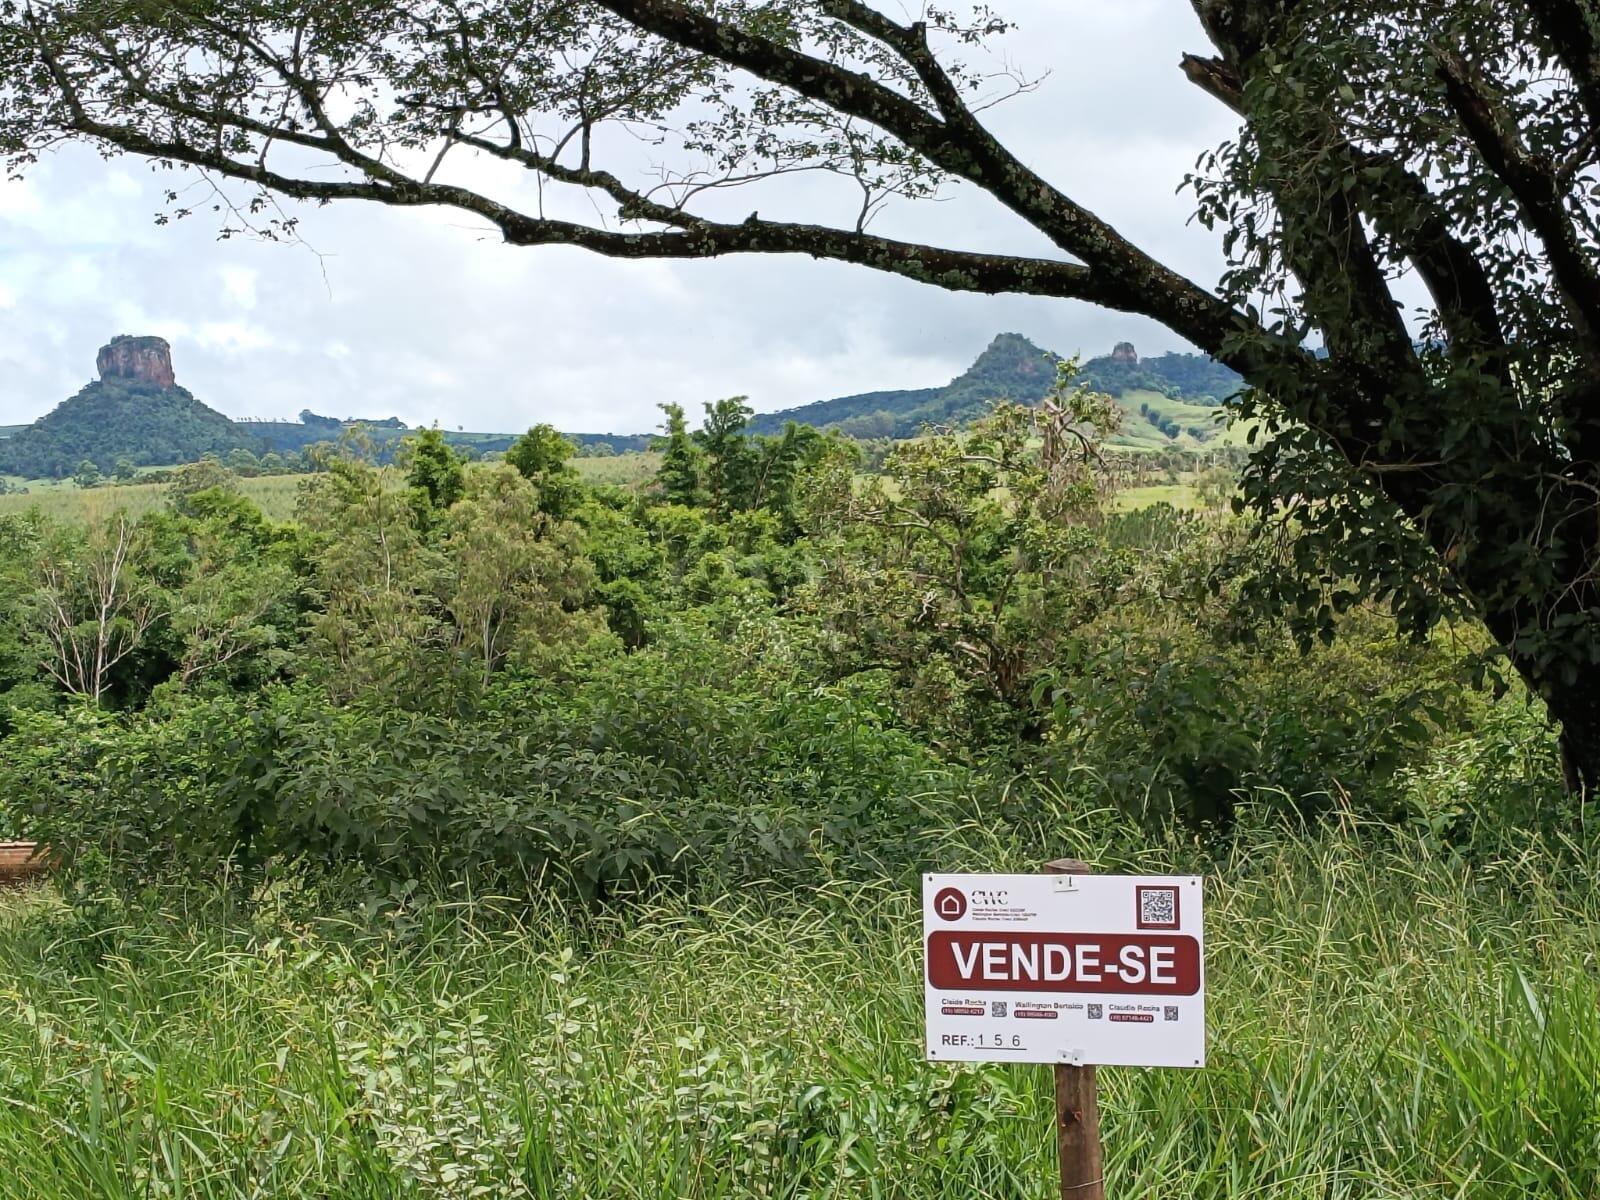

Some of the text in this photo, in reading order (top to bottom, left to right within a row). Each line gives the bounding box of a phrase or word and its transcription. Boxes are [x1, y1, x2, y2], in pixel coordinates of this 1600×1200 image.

[950, 942, 1177, 984] VENDE-SE
[942, 1034, 1021, 1047] REF.: 1 5 6
